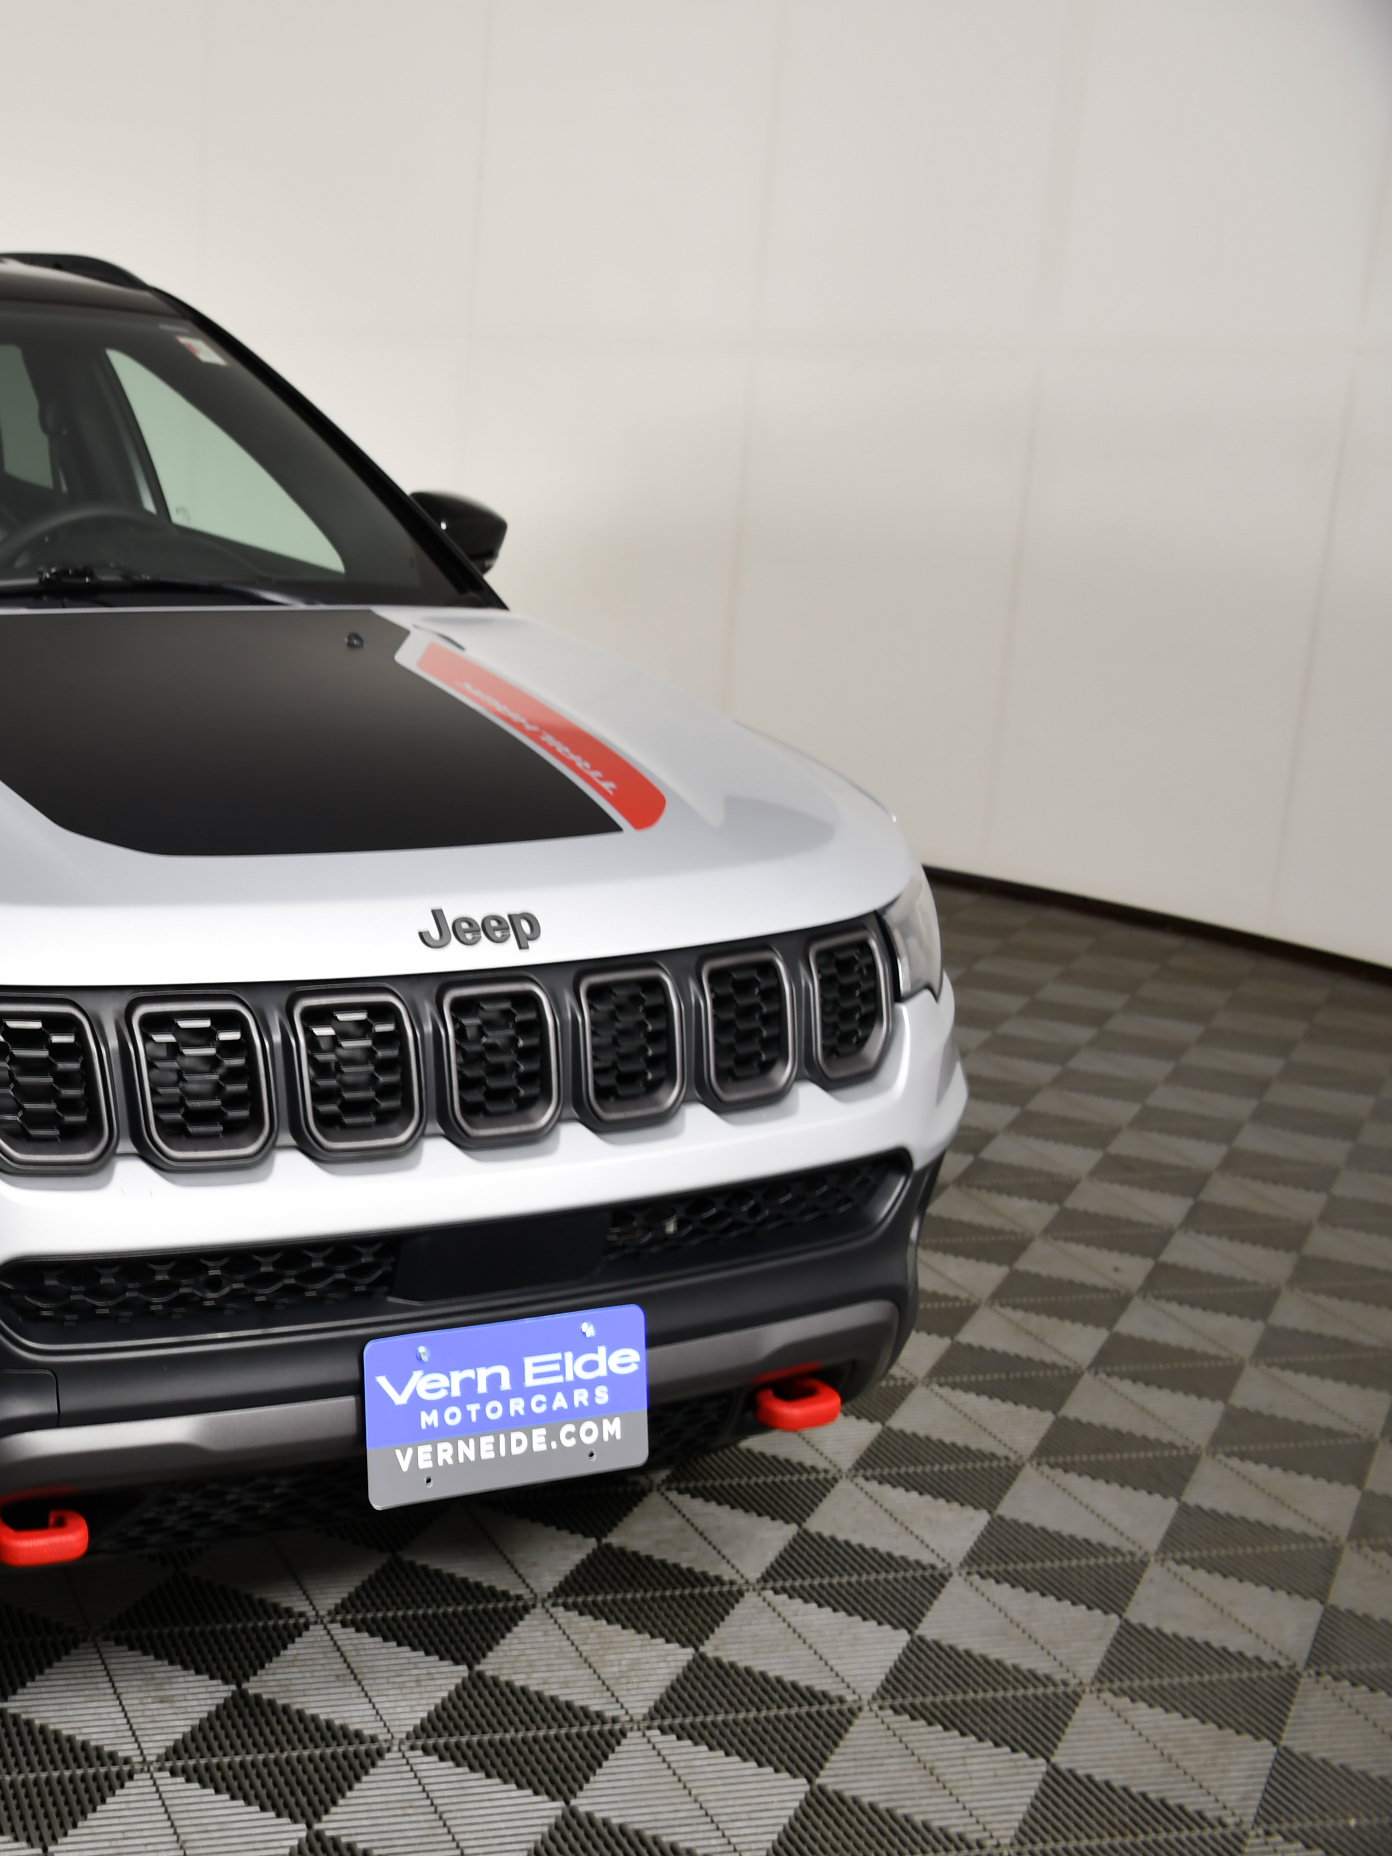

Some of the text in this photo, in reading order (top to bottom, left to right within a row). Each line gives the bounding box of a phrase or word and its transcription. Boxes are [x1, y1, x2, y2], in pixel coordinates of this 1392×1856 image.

[418, 908, 541, 950] Jeep
[375, 1364, 511, 1405] Vern
[420, 1385, 609, 1429] MOTORCARS
[395, 1417, 621, 1472] VERNEIDE.COM
